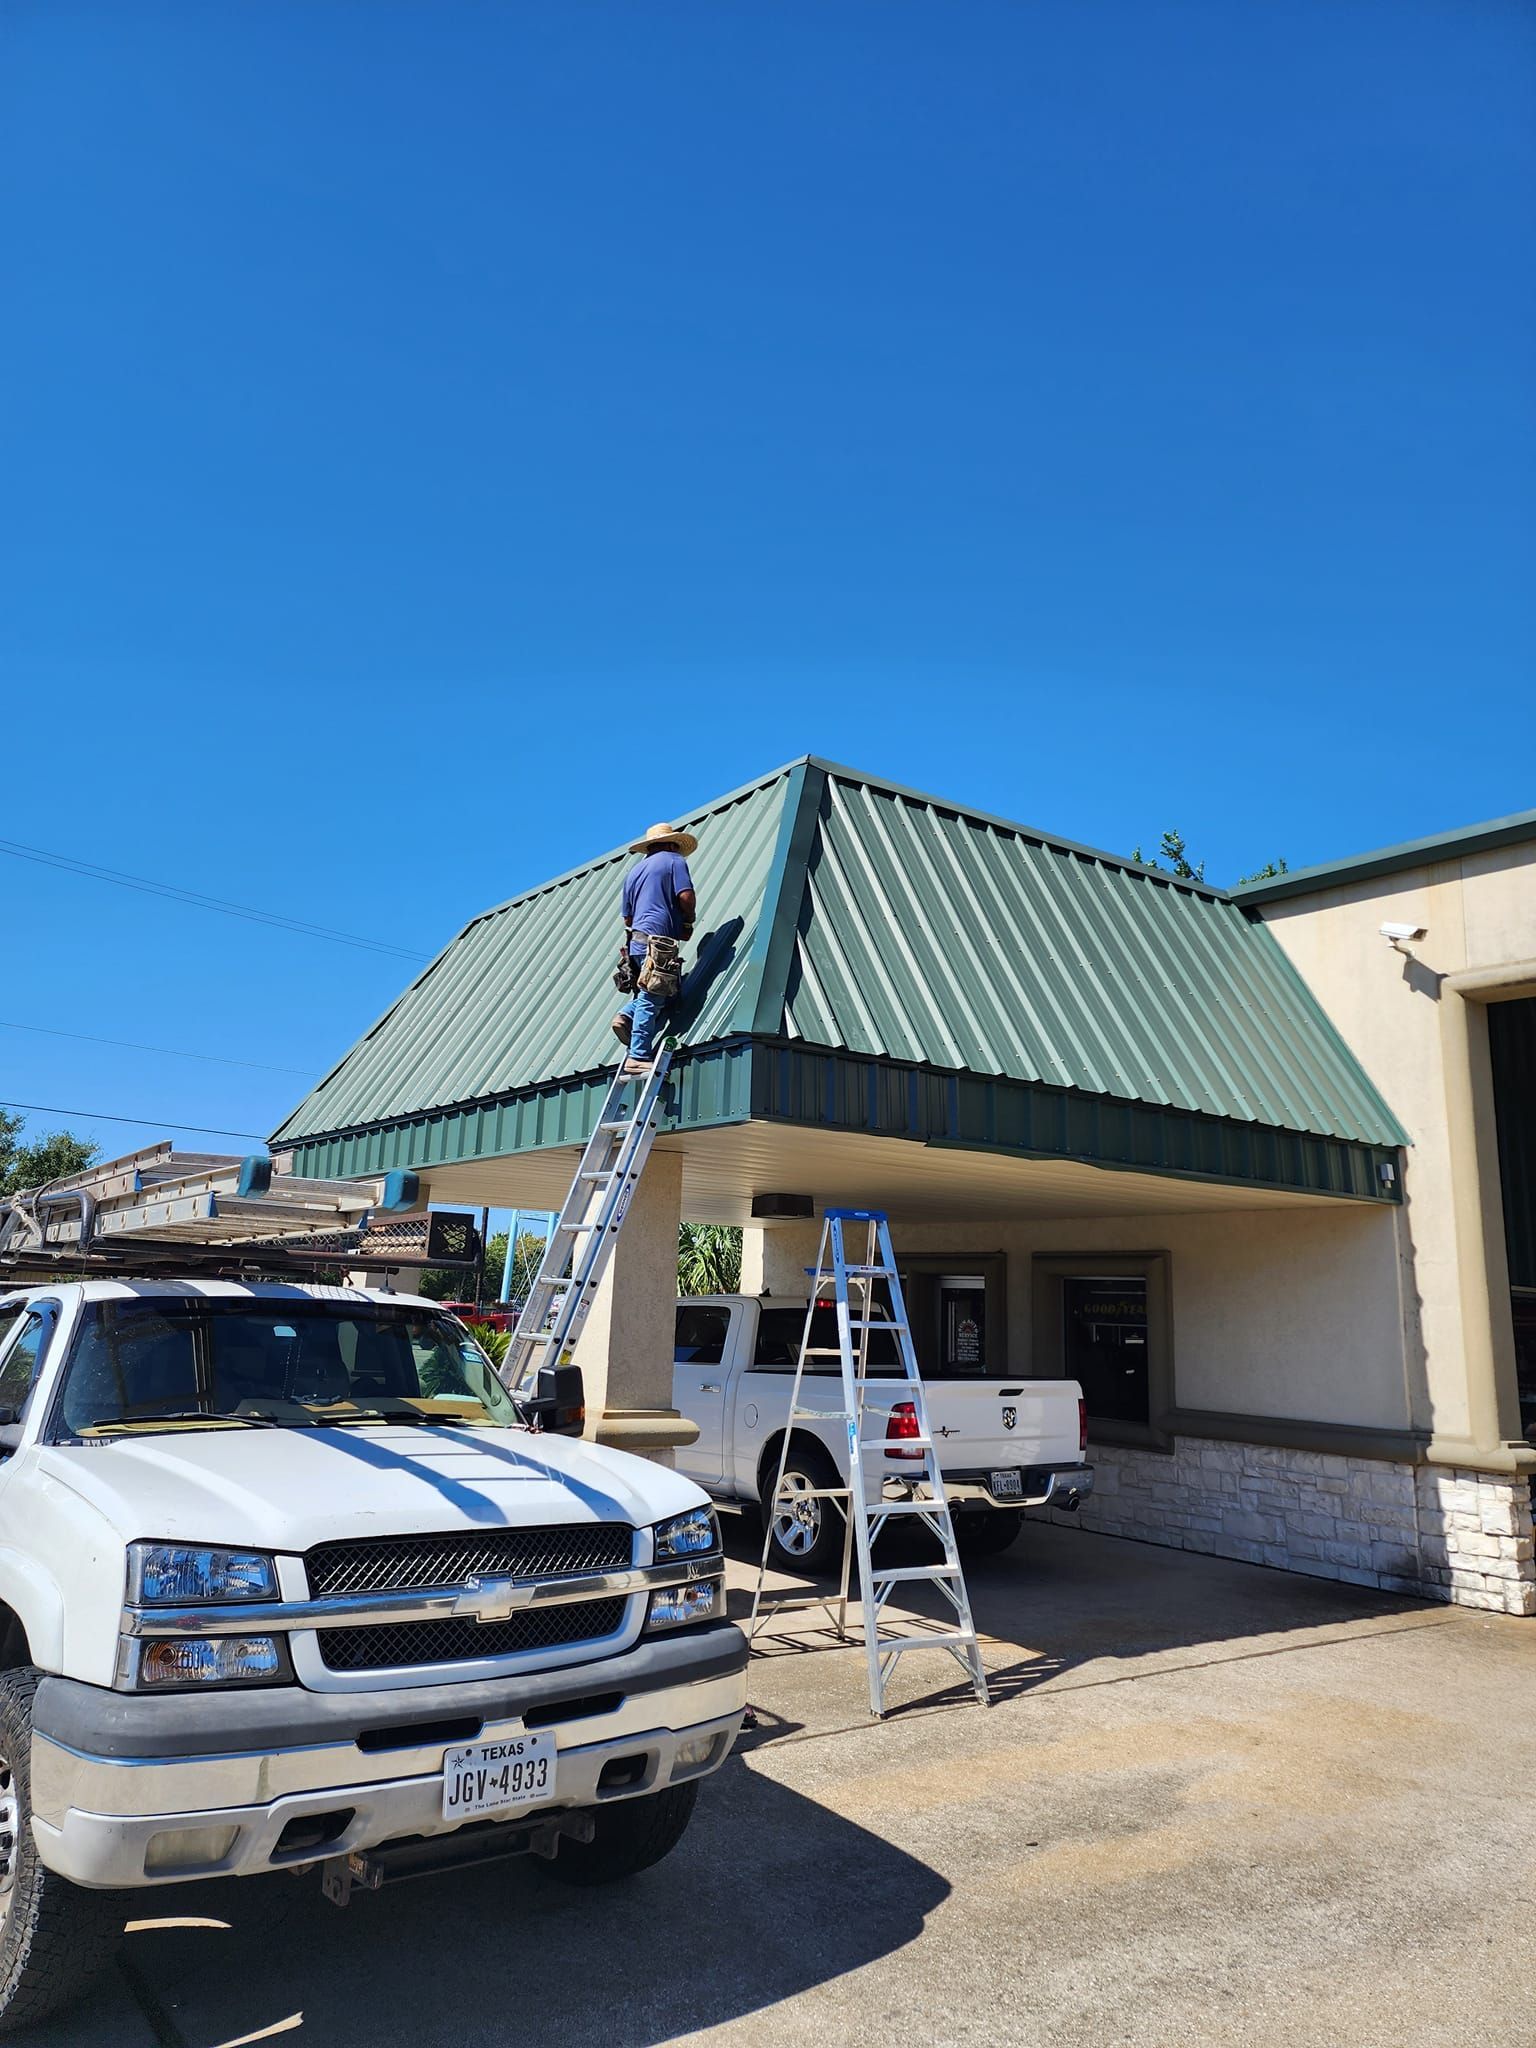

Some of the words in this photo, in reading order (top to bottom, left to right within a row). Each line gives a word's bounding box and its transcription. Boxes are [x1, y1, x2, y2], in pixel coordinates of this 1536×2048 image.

[1084, 1301, 1147, 1315] GOODYEA
[481, 1742, 524, 1761] TEXAS
[449, 1769, 487, 1805] JGV
[499, 1758, 547, 1795] 4933
